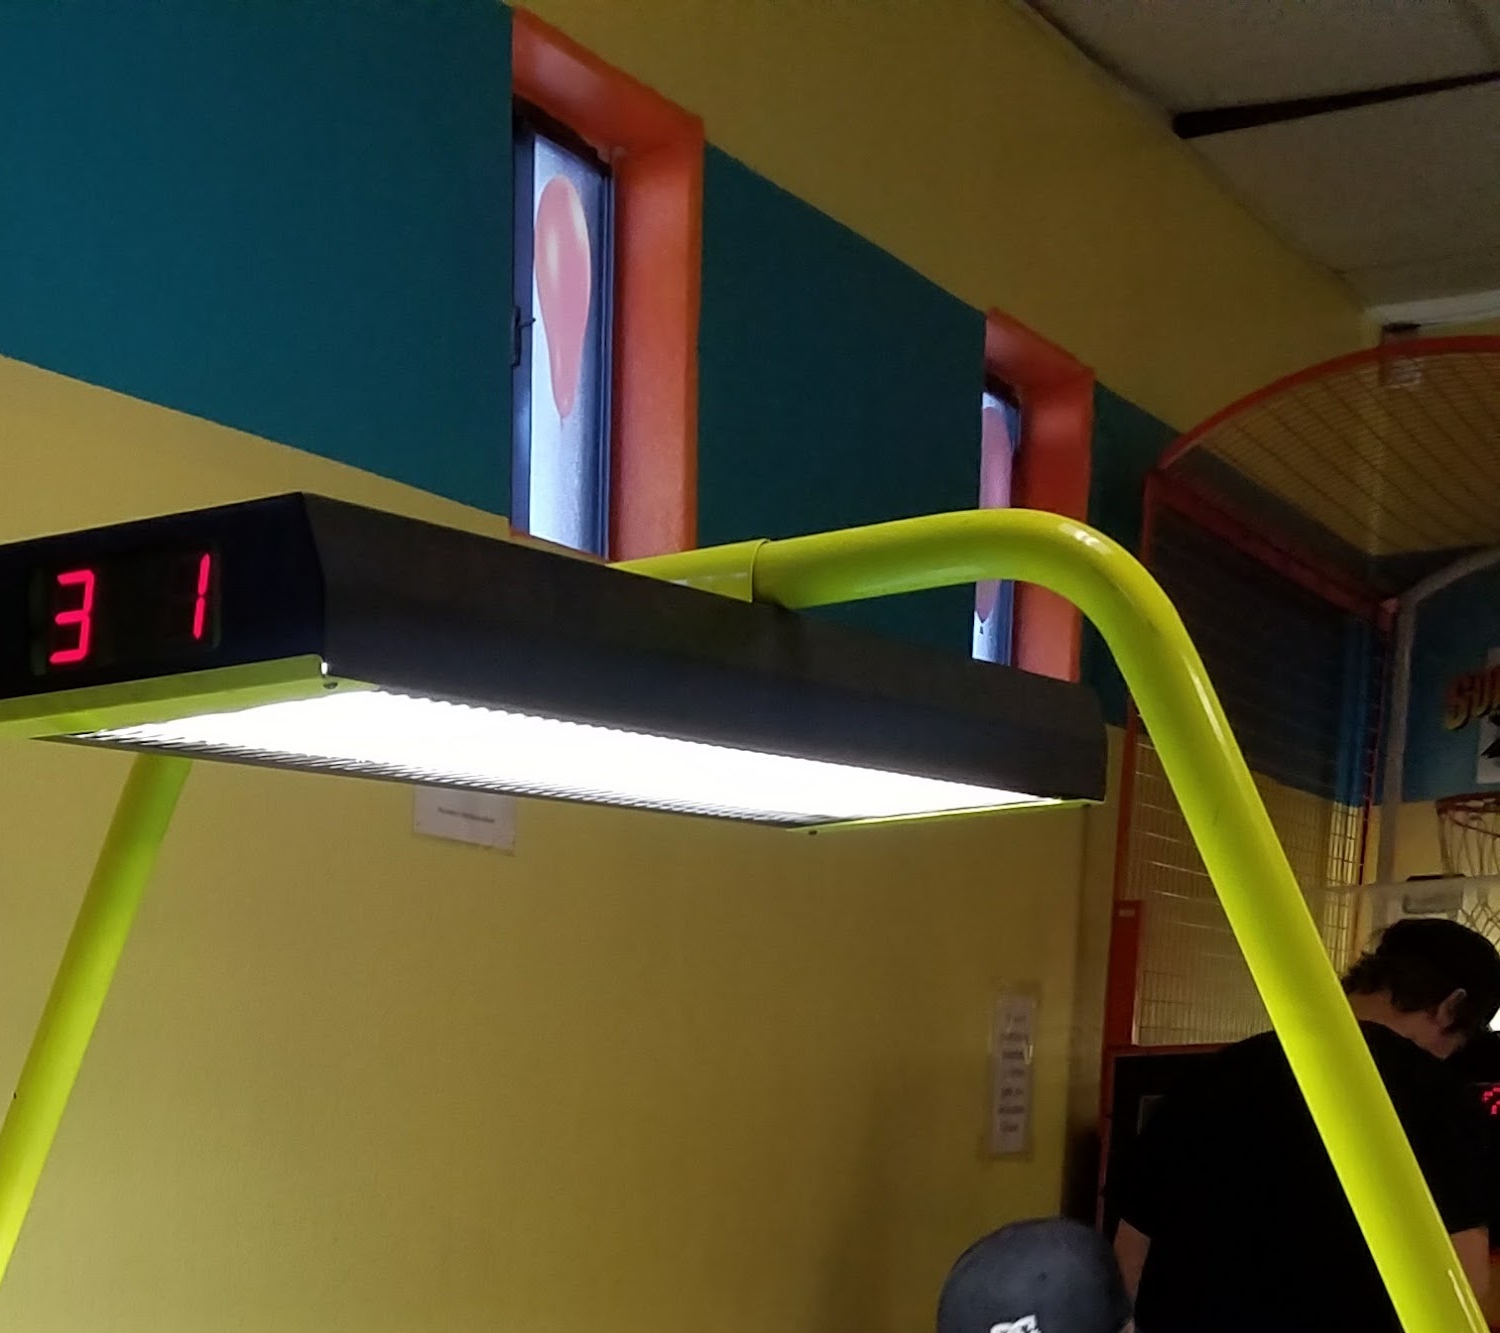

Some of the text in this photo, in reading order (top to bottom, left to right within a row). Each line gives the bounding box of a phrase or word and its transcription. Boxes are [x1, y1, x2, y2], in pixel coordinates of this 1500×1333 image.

[49, 553, 211, 665] 3 1
[1444, 664, 1500, 731] SU
